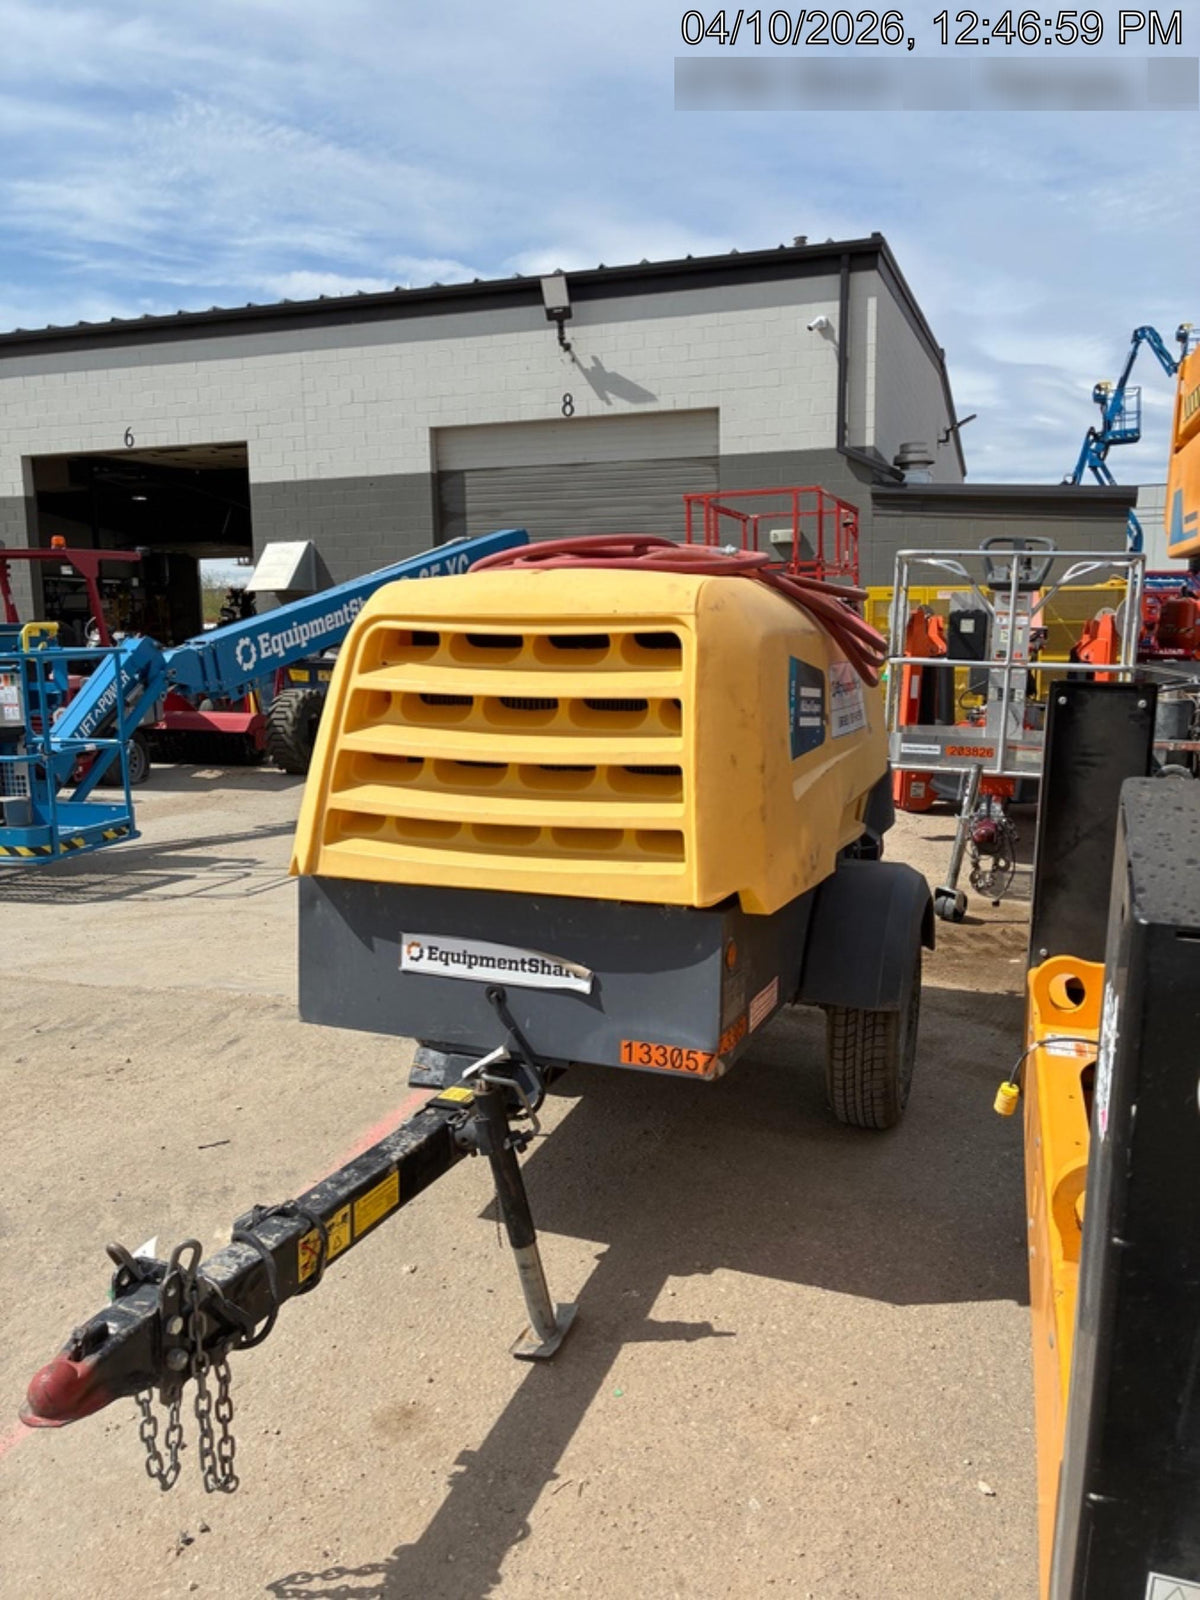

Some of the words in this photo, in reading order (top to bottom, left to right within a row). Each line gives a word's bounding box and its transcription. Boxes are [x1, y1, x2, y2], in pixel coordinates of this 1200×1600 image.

[562, 391, 574, 417] 8
[124, 426, 135, 449] 6
[624, 1041, 715, 1072] 133057
